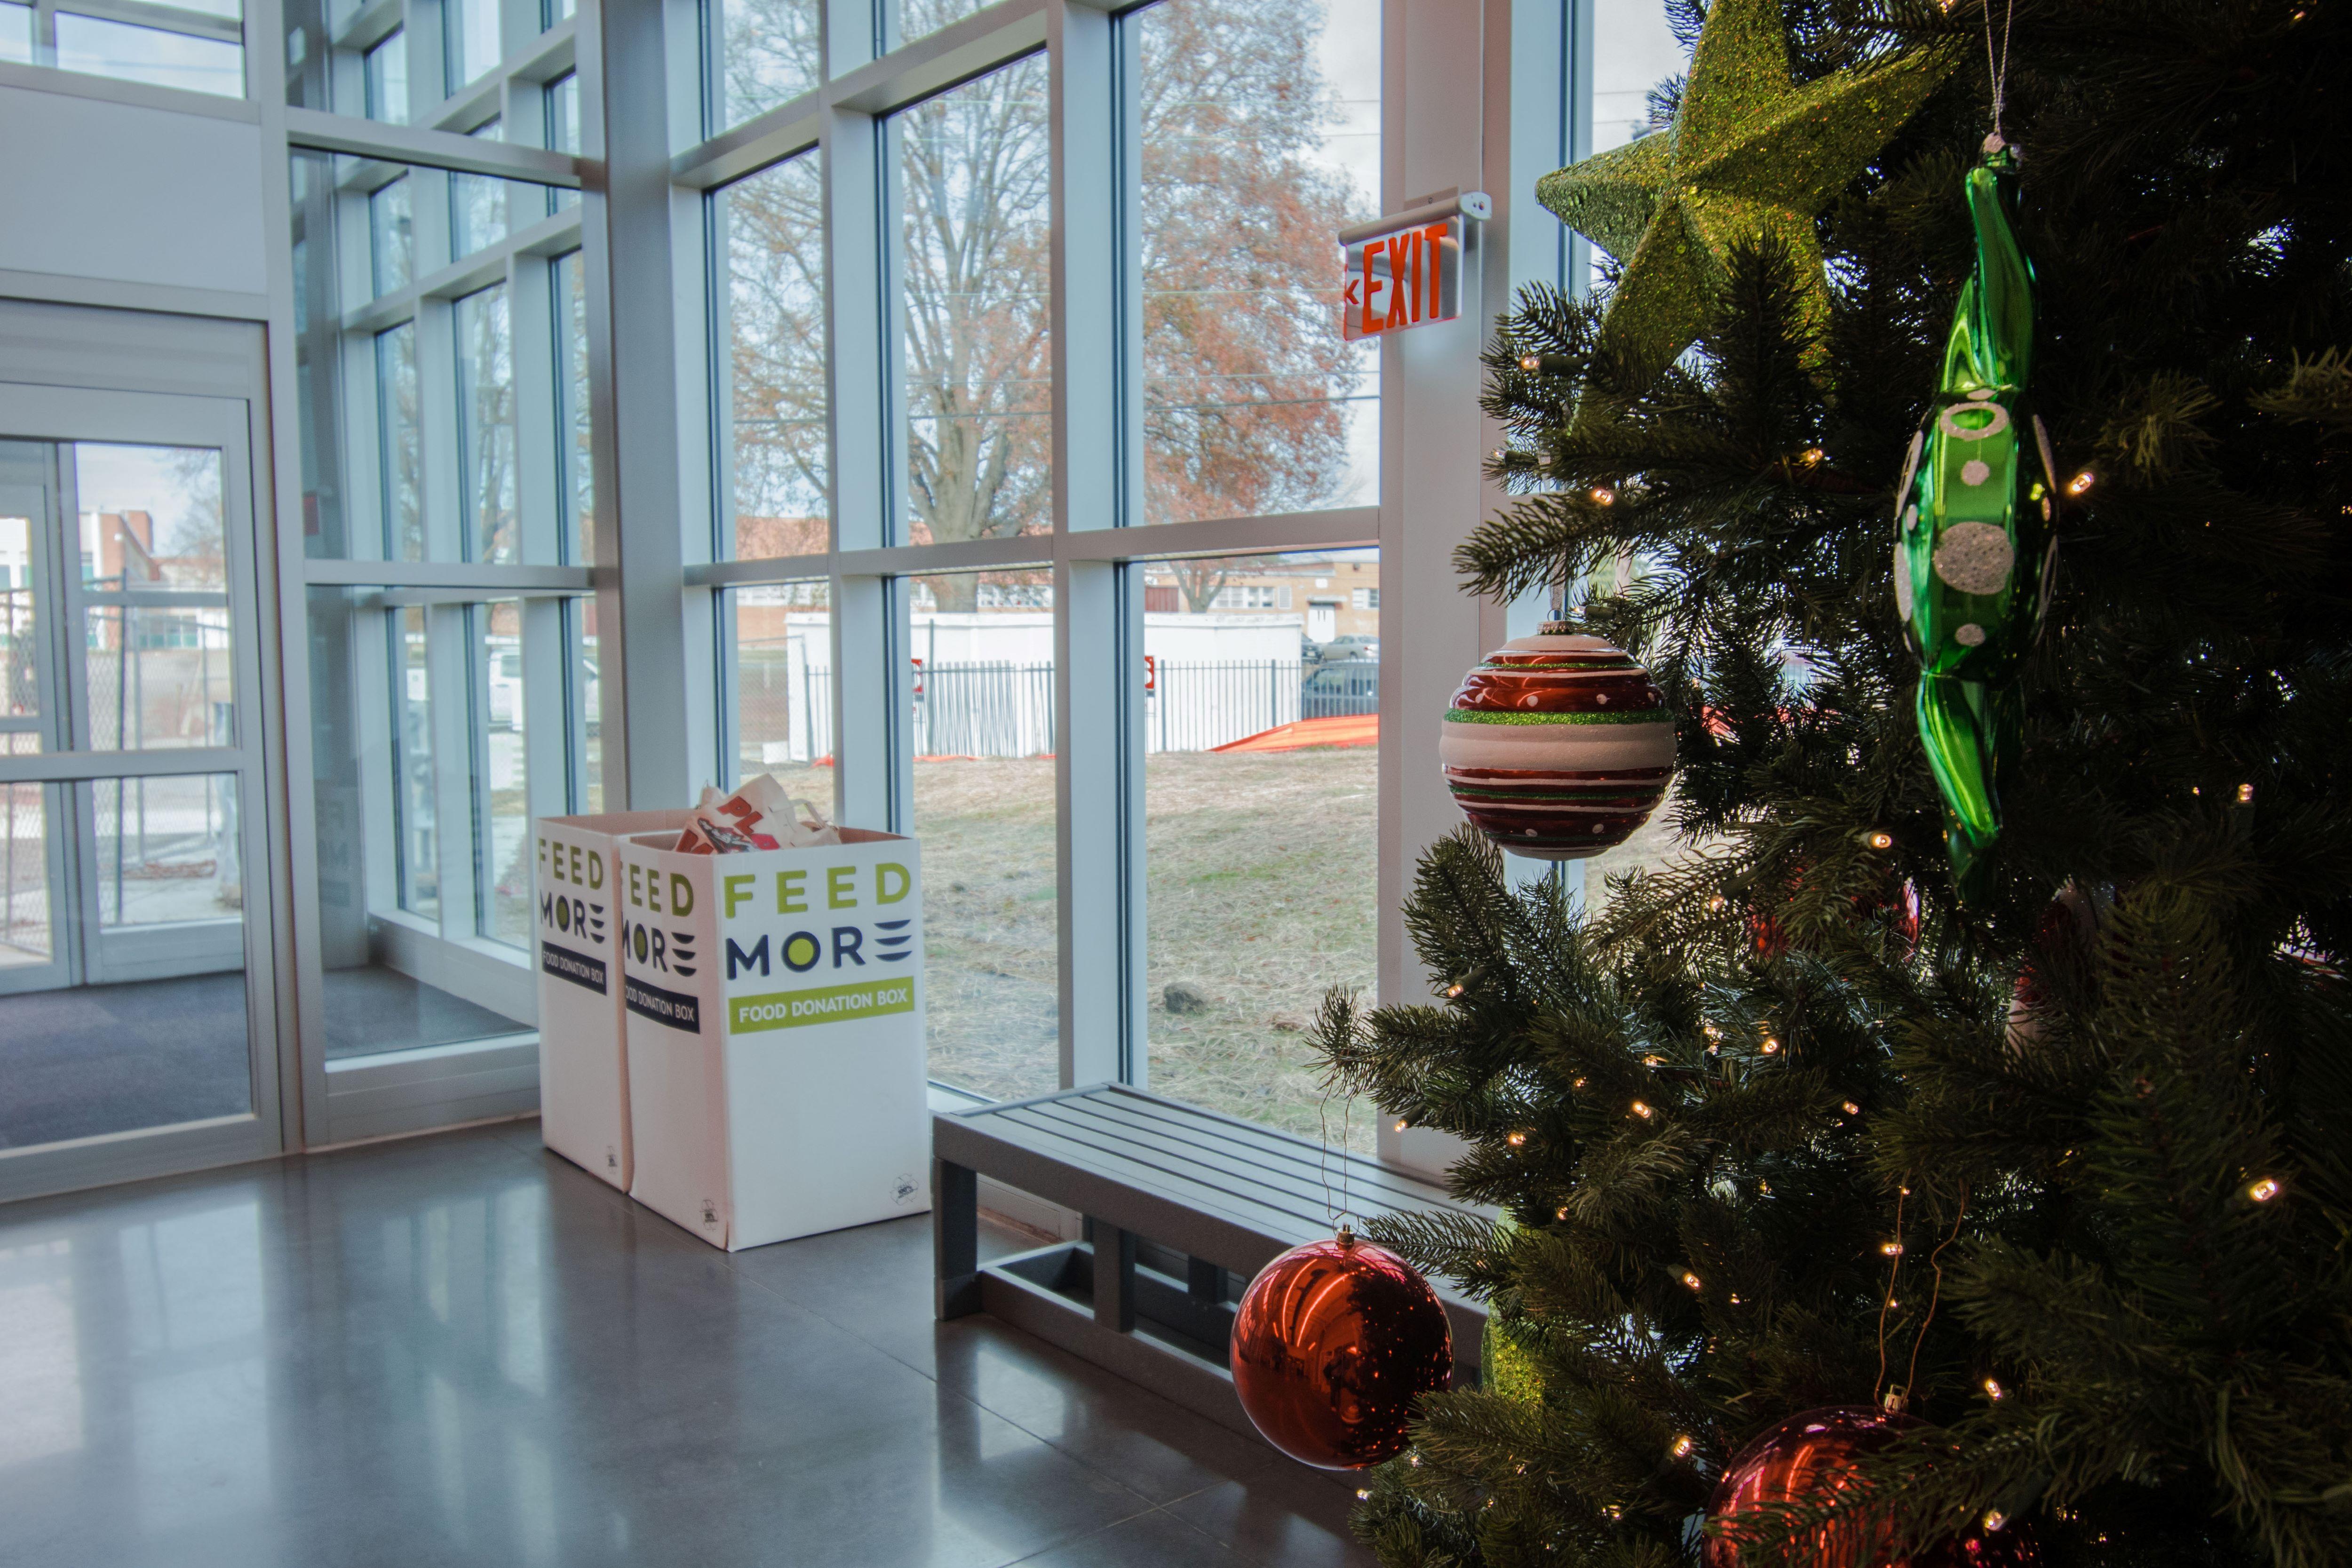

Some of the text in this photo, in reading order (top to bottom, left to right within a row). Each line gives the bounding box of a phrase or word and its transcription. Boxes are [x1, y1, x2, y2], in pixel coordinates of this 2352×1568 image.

[1362, 223, 1447, 333] EXIT
[539, 838, 604, 890] FEED
[620, 861, 694, 917] EED
[723, 862, 911, 919] FEED
[540, 889, 605, 944] MORE
[543, 951, 604, 985] FOOD DONATION BOX
[725, 919, 913, 981] MORE
[638, 991, 673, 1017] DONATION
[675, 1004, 695, 1022] BOX
[739, 988, 908, 1024] FOOD DONATION BOX
